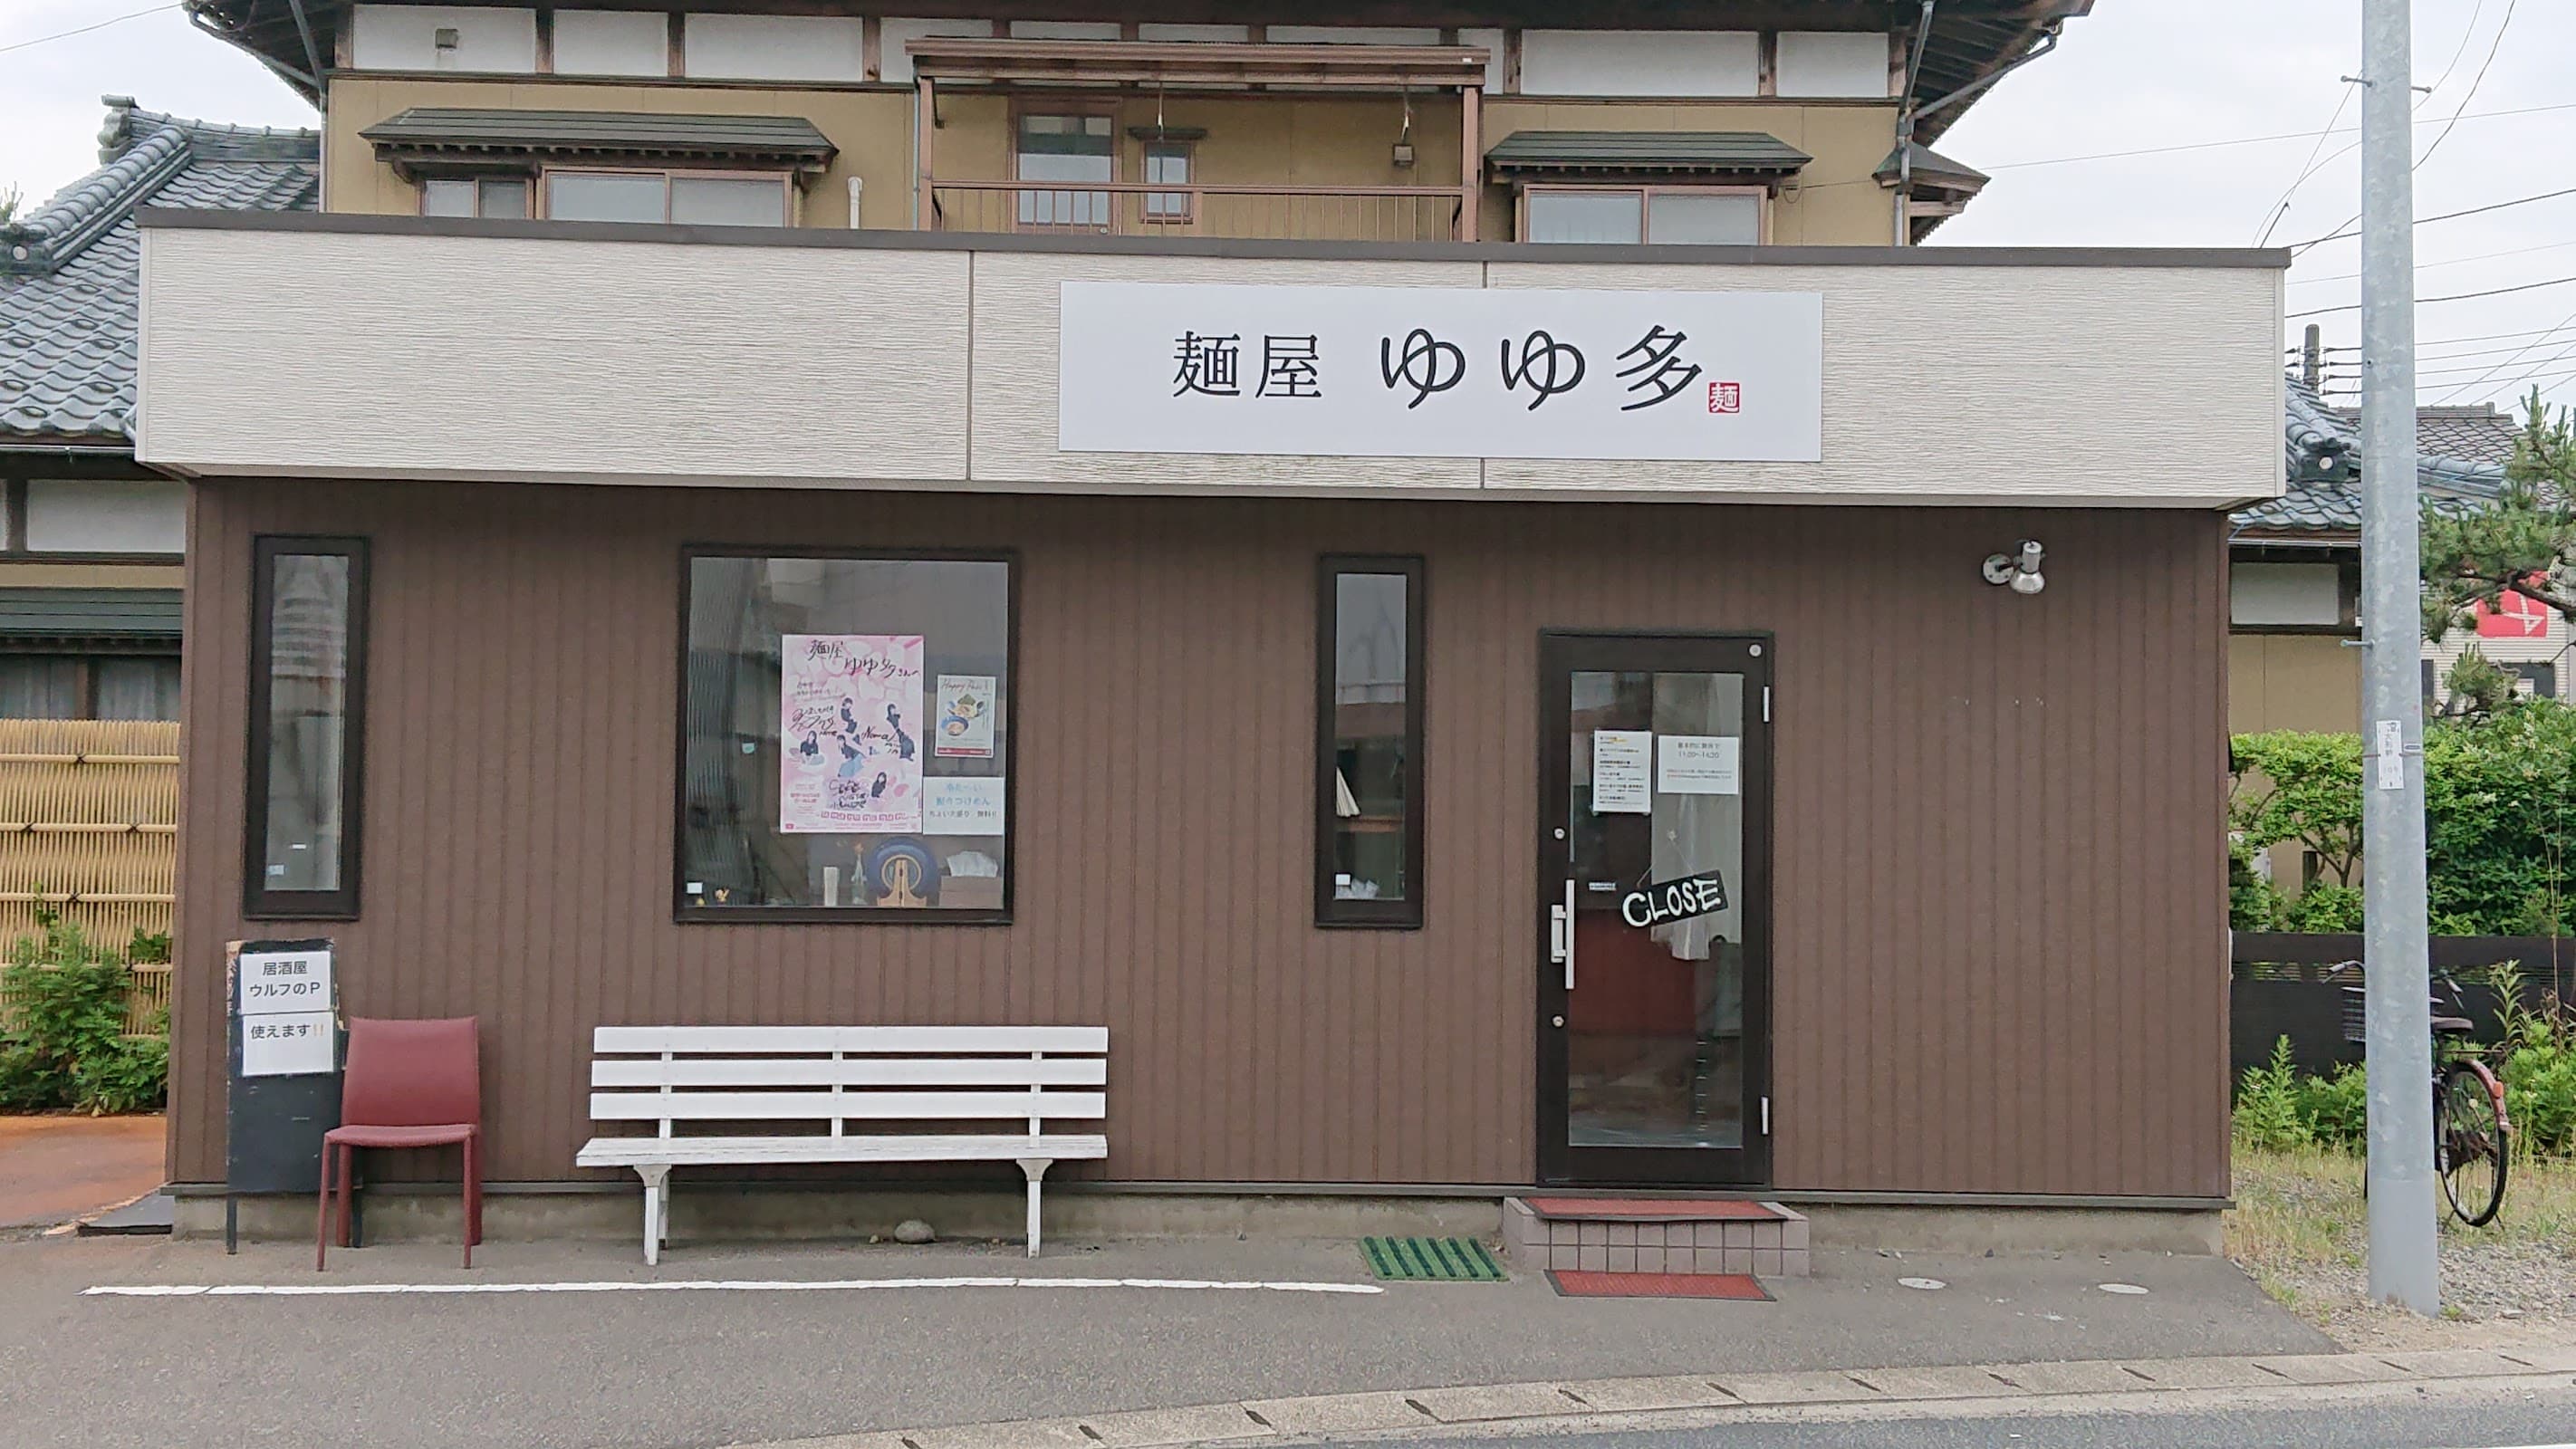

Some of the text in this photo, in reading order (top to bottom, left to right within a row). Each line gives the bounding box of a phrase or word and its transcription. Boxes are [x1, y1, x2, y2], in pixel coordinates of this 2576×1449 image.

[1172, 324, 1703, 412] 麺屋 ゆゆ多
[1708, 382, 1741, 414] 麺
[1621, 878, 1721, 927] CLOSE
[263, 961, 308, 976] 居酒屋
[249, 981, 321, 997] ウルフのP
